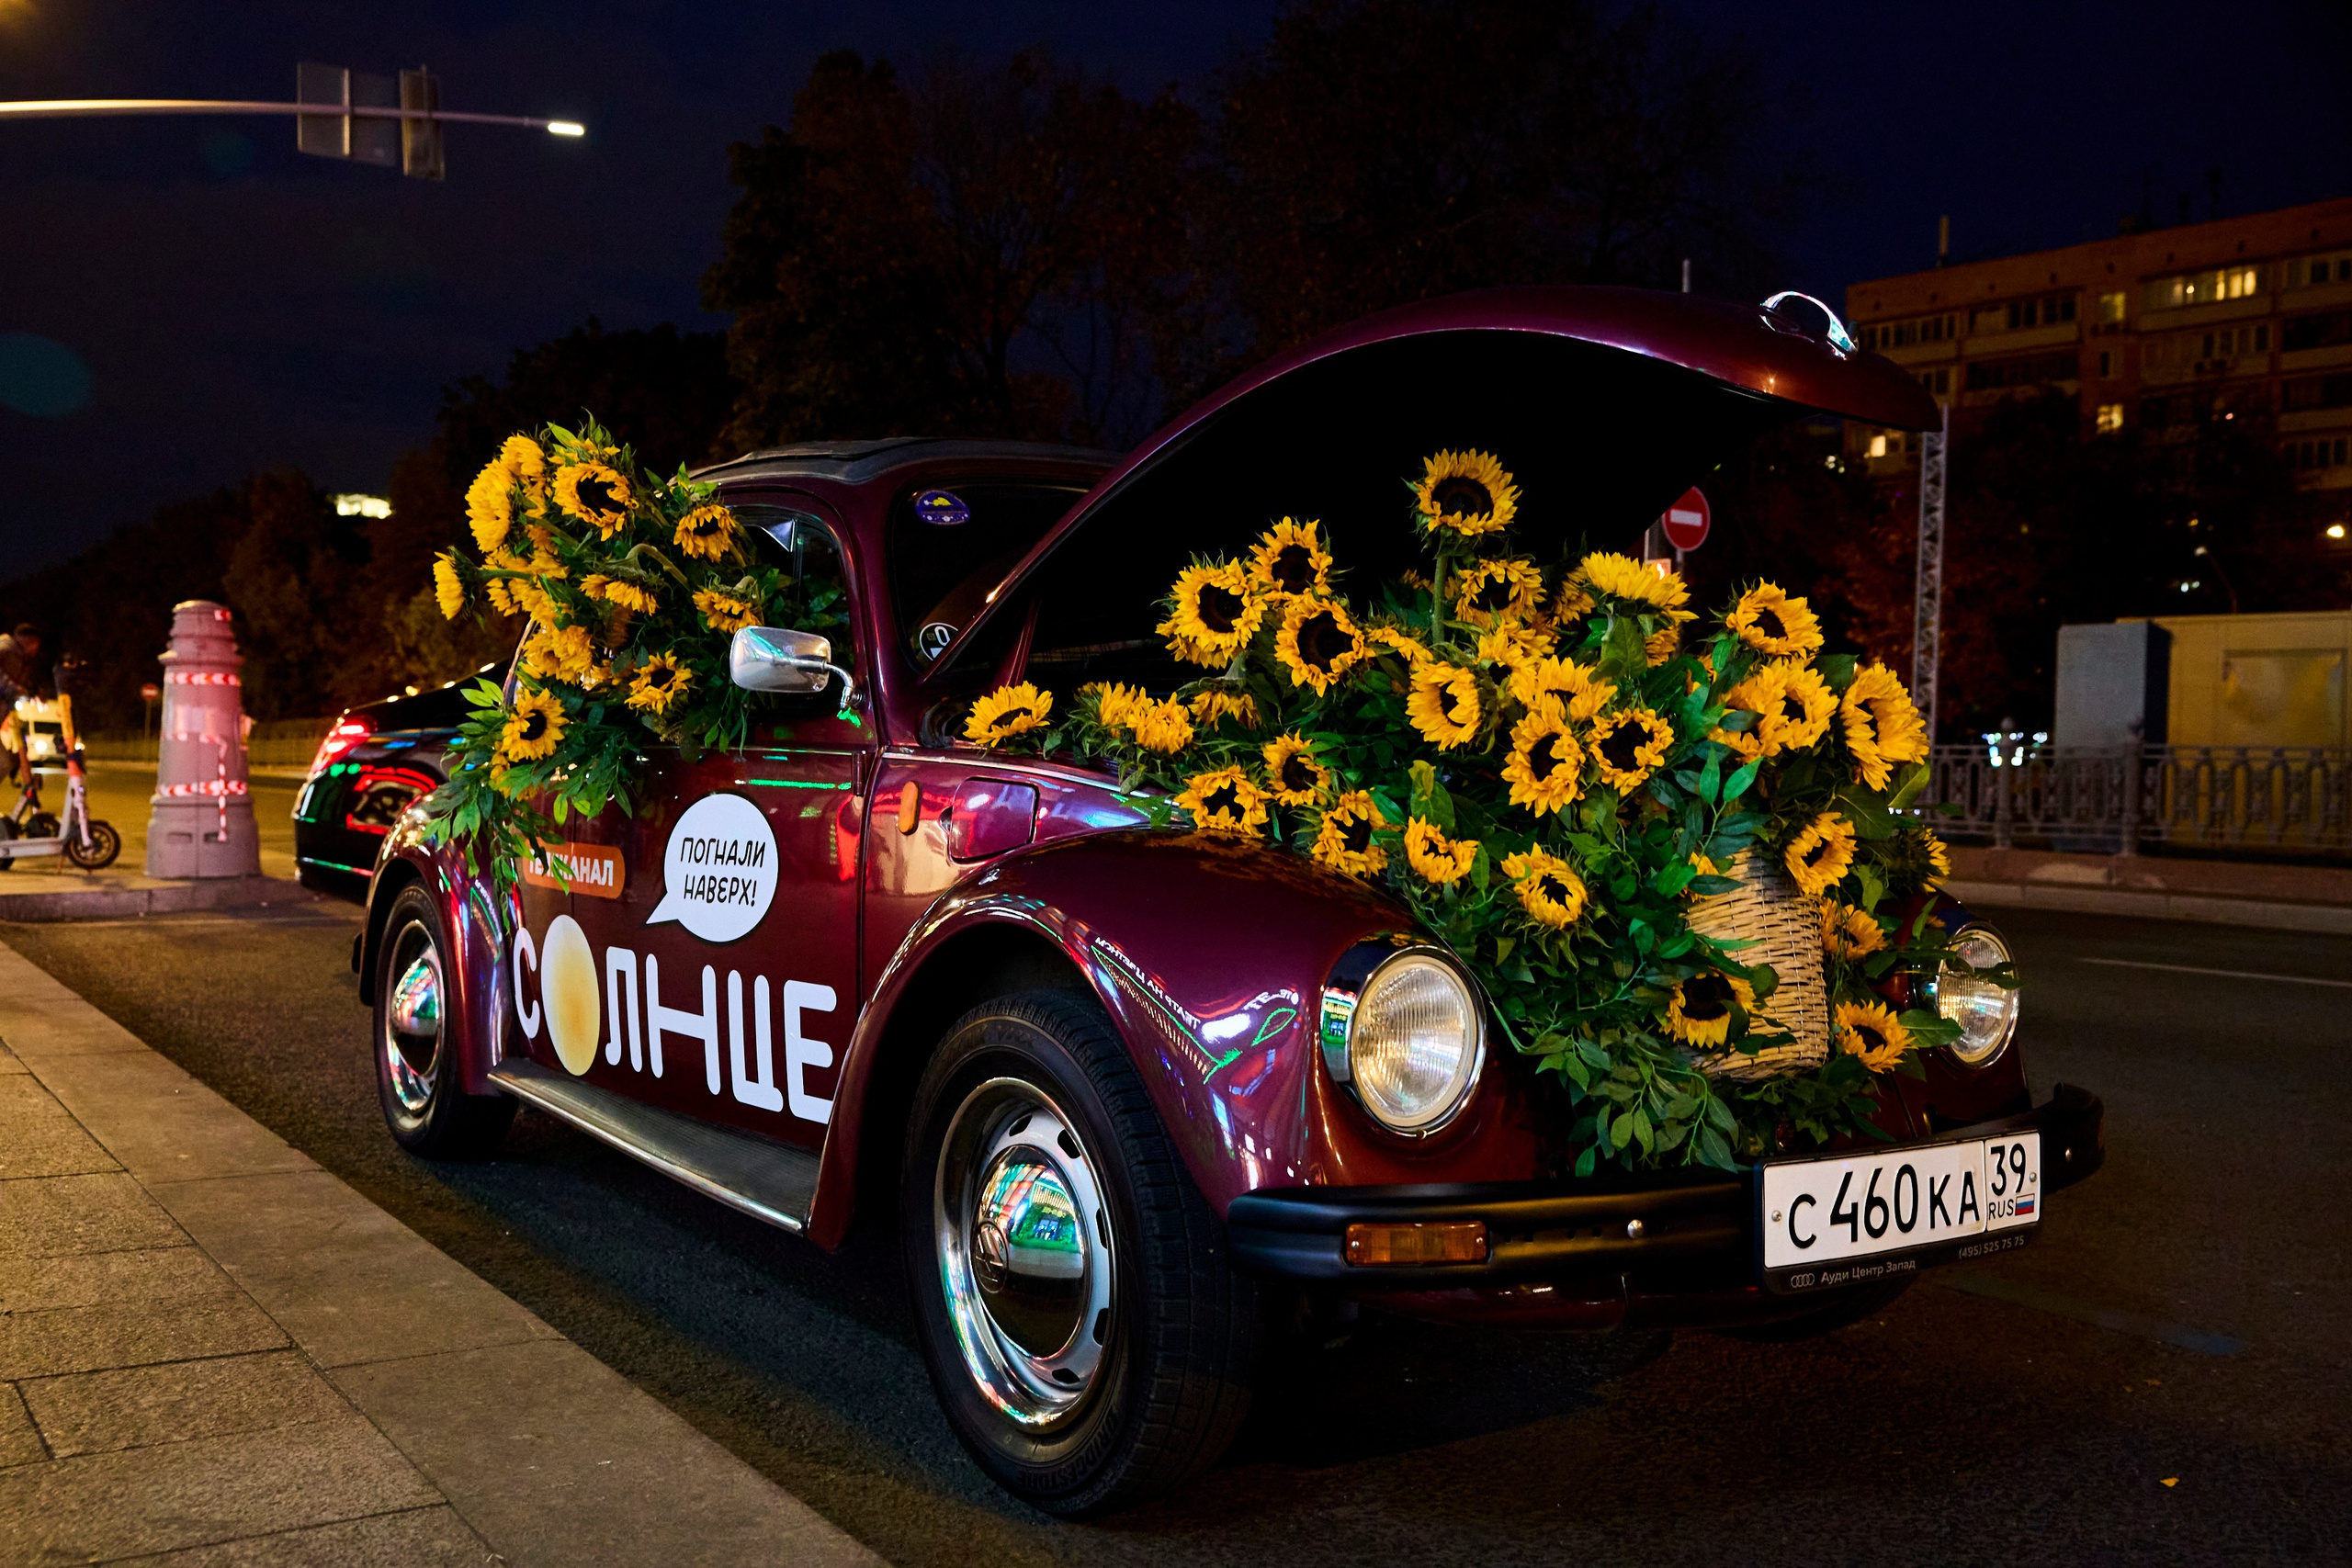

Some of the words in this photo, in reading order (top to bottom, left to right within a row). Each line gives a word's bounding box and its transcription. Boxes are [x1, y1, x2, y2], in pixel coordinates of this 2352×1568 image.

[680, 837, 766, 868] ПОГНАЛИ
[684, 874, 757, 907] НАВЕРХ!
[1990, 1143, 2027, 1196] 39
[1988, 1198, 2014, 1221] RUS
[1958, 1245, 1982, 1259] (495)
[1983, 1240, 2000, 1255] 525
[2001, 1237, 2013, 1250] 75
[2014, 1235, 2025, 1247] 75
[1820, 1269, 1849, 1285] Ауди
[1851, 1265, 1883, 1280] Центр
[1886, 1259, 1917, 1273] Запад
